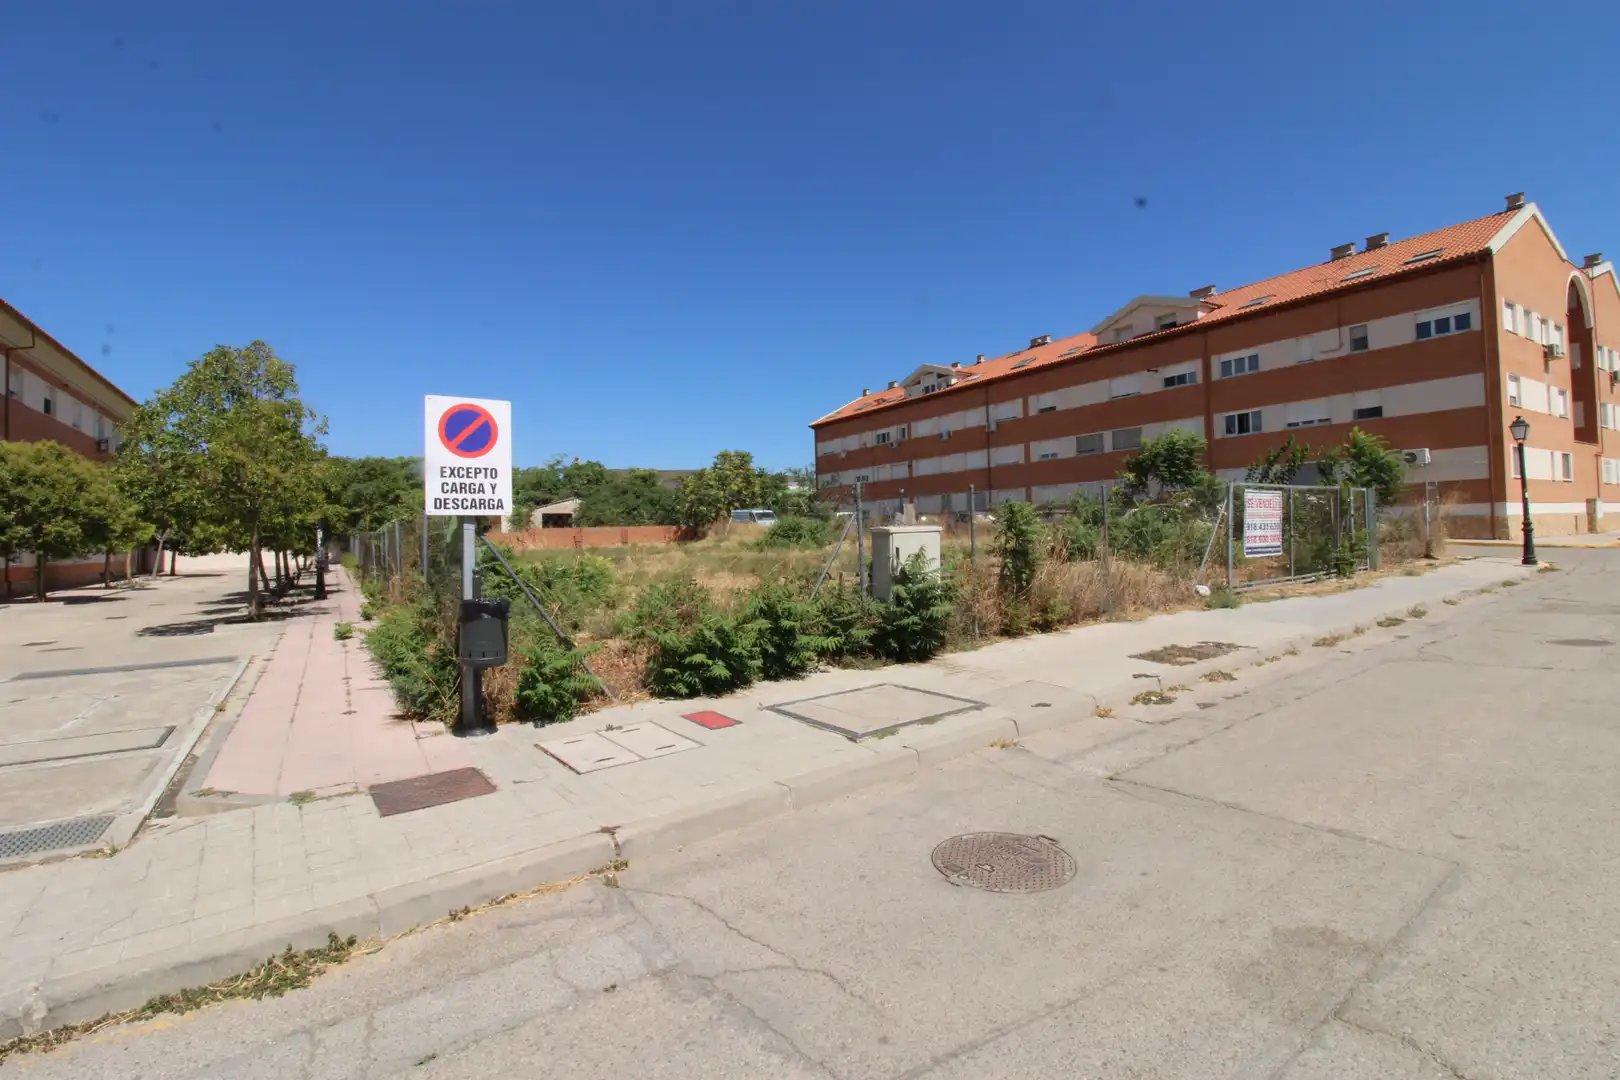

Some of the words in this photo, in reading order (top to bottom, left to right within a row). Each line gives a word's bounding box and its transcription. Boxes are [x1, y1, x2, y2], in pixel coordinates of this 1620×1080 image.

[440, 466, 498, 479] EXCEPTO
[441, 482, 486, 494] CARGA
[490, 483, 497, 494] Y
[434, 498, 504, 510] DESCARGA
